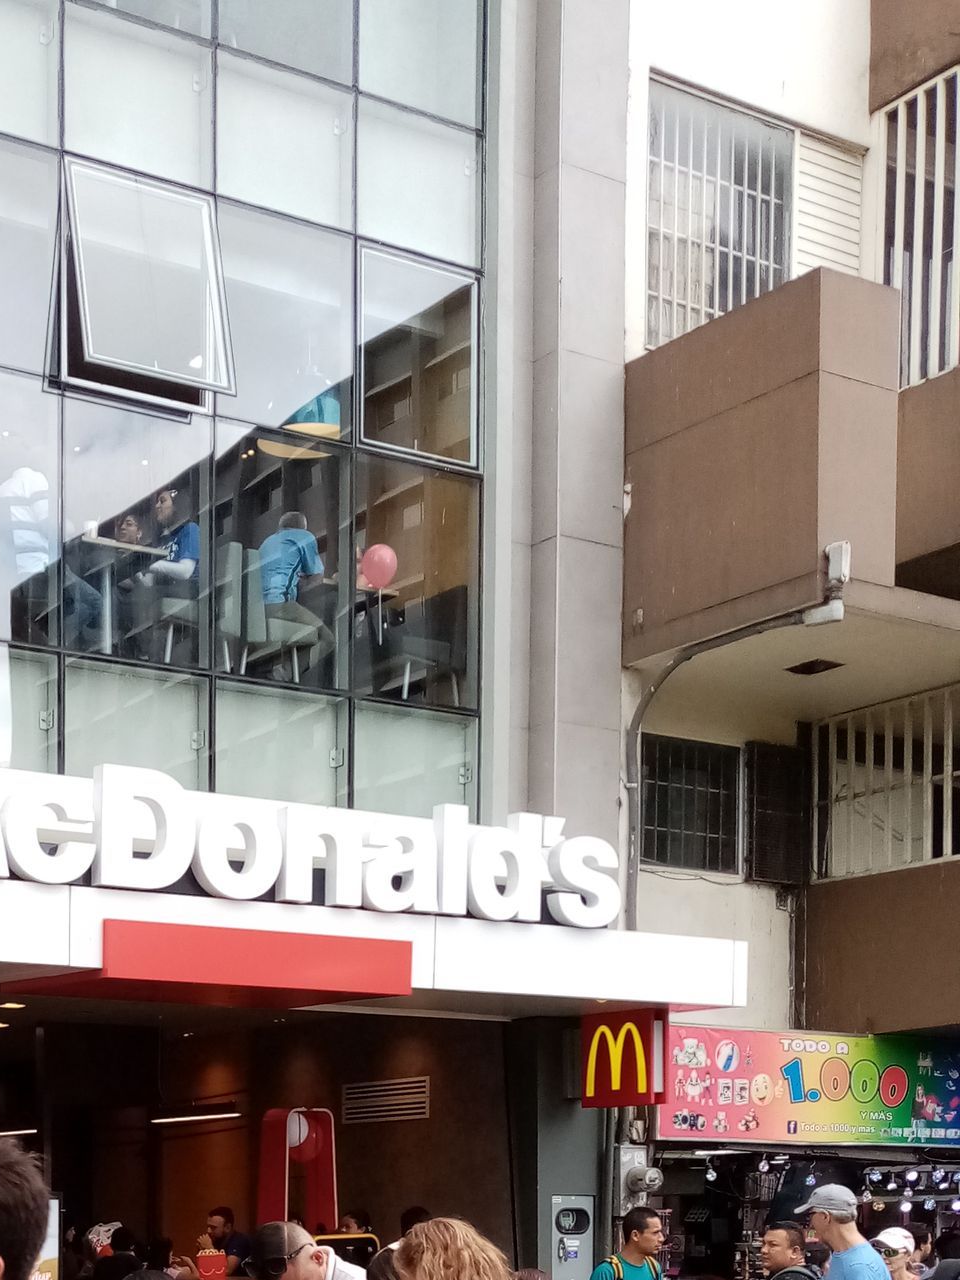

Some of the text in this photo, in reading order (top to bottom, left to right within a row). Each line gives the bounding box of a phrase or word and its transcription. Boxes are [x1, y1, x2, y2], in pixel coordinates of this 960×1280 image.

[780, 1038, 830, 1053] TODO
[586, 1022, 648, 1098] M
[780, 1057, 909, 1109] 1.000
[860, 1110, 869, 1120] Y
[801, 1122, 821, 1132] Todo
[830, 1123, 849, 1132] 1000
